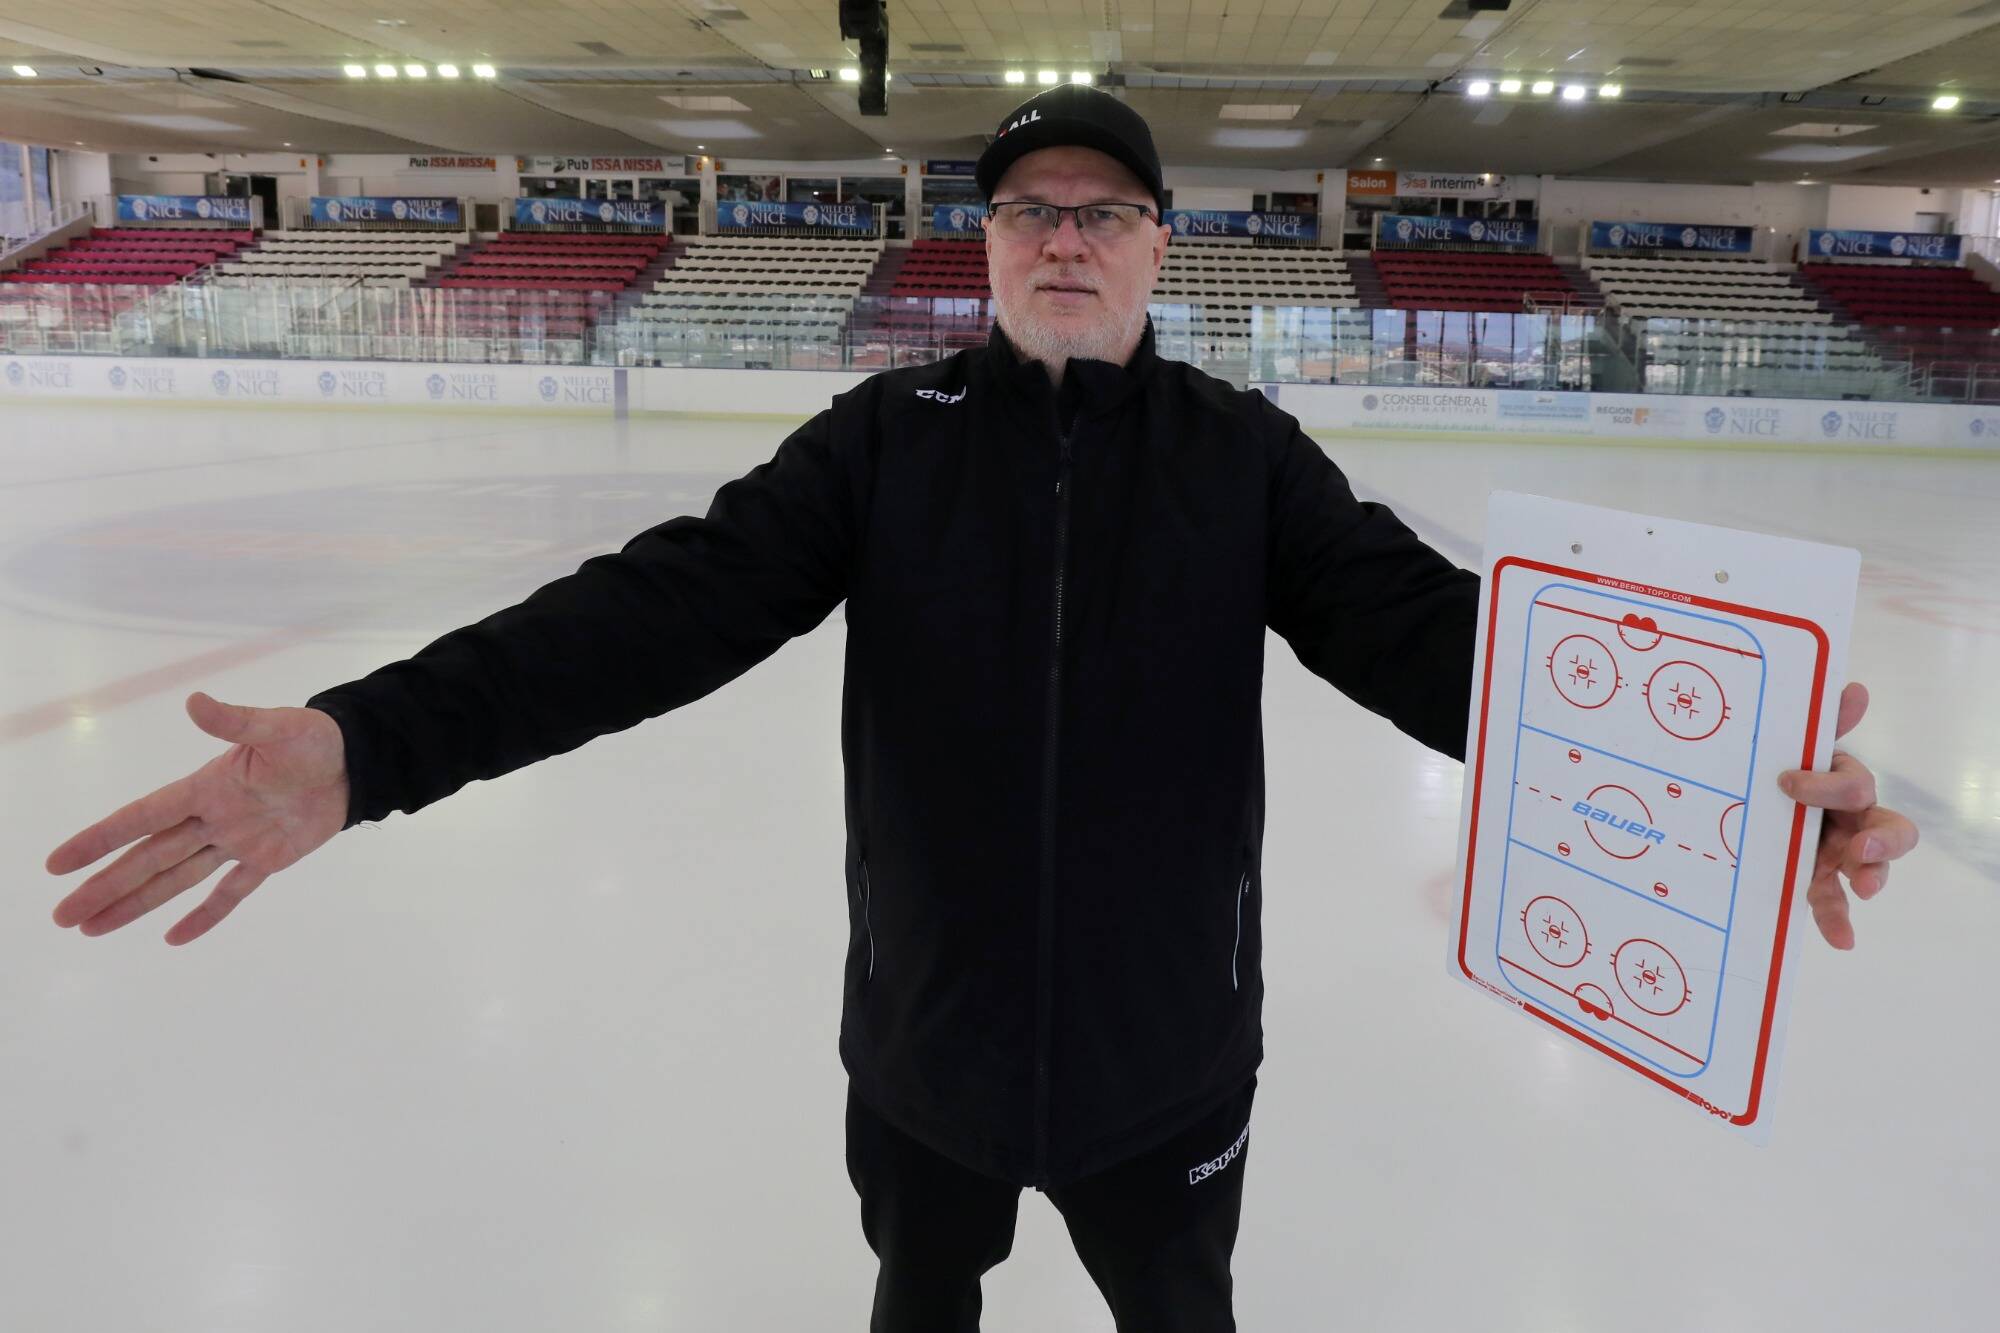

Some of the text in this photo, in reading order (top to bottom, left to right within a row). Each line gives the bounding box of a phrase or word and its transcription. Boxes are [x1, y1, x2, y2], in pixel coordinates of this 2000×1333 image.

[567, 159, 589, 170] Pub
[591, 158, 622, 171] ISSA
[624, 158, 663, 172] NISSA
[1351, 176, 1387, 188] Salon
[1430, 176, 1476, 190] interim
[148, 205, 183, 218] NICE
[212, 207, 248, 219] NICE
[343, 207, 377, 219] NICE
[409, 208, 444, 220] NICE
[820, 205, 843, 213] VILLE
[548, 210, 583, 222] NICE
[616, 210, 652, 223] NICE
[751, 212, 786, 224] NICE
[821, 213, 857, 226] NICE
[1264, 215, 1286, 223] VILLE
[1192, 222, 1229, 234] NICE
[1264, 223, 1301, 236] NICE
[1414, 227, 1452, 240] NICE
[1487, 229, 1524, 242] NICE
[1627, 234, 1664, 247] NICE
[1698, 236, 1736, 249] NICE
[1836, 241, 1873, 254] NICE
[1907, 244, 1945, 257] NICE
[29, 372, 73, 388] NICE
[450, 373, 480, 384] VILLE
[563, 375, 593, 386] VILLE
[132, 378, 177, 393] NICE
[236, 381, 281, 396] NICE
[341, 381, 387, 397] NICE
[451, 385, 497, 400] NICE
[564, 387, 612, 403] NICE
[1382, 394, 1430, 405] CONSEIL
[1613, 416, 1632, 424] SUD
[1730, 419, 1781, 436] NICE
[1847, 423, 1898, 440] NICE
